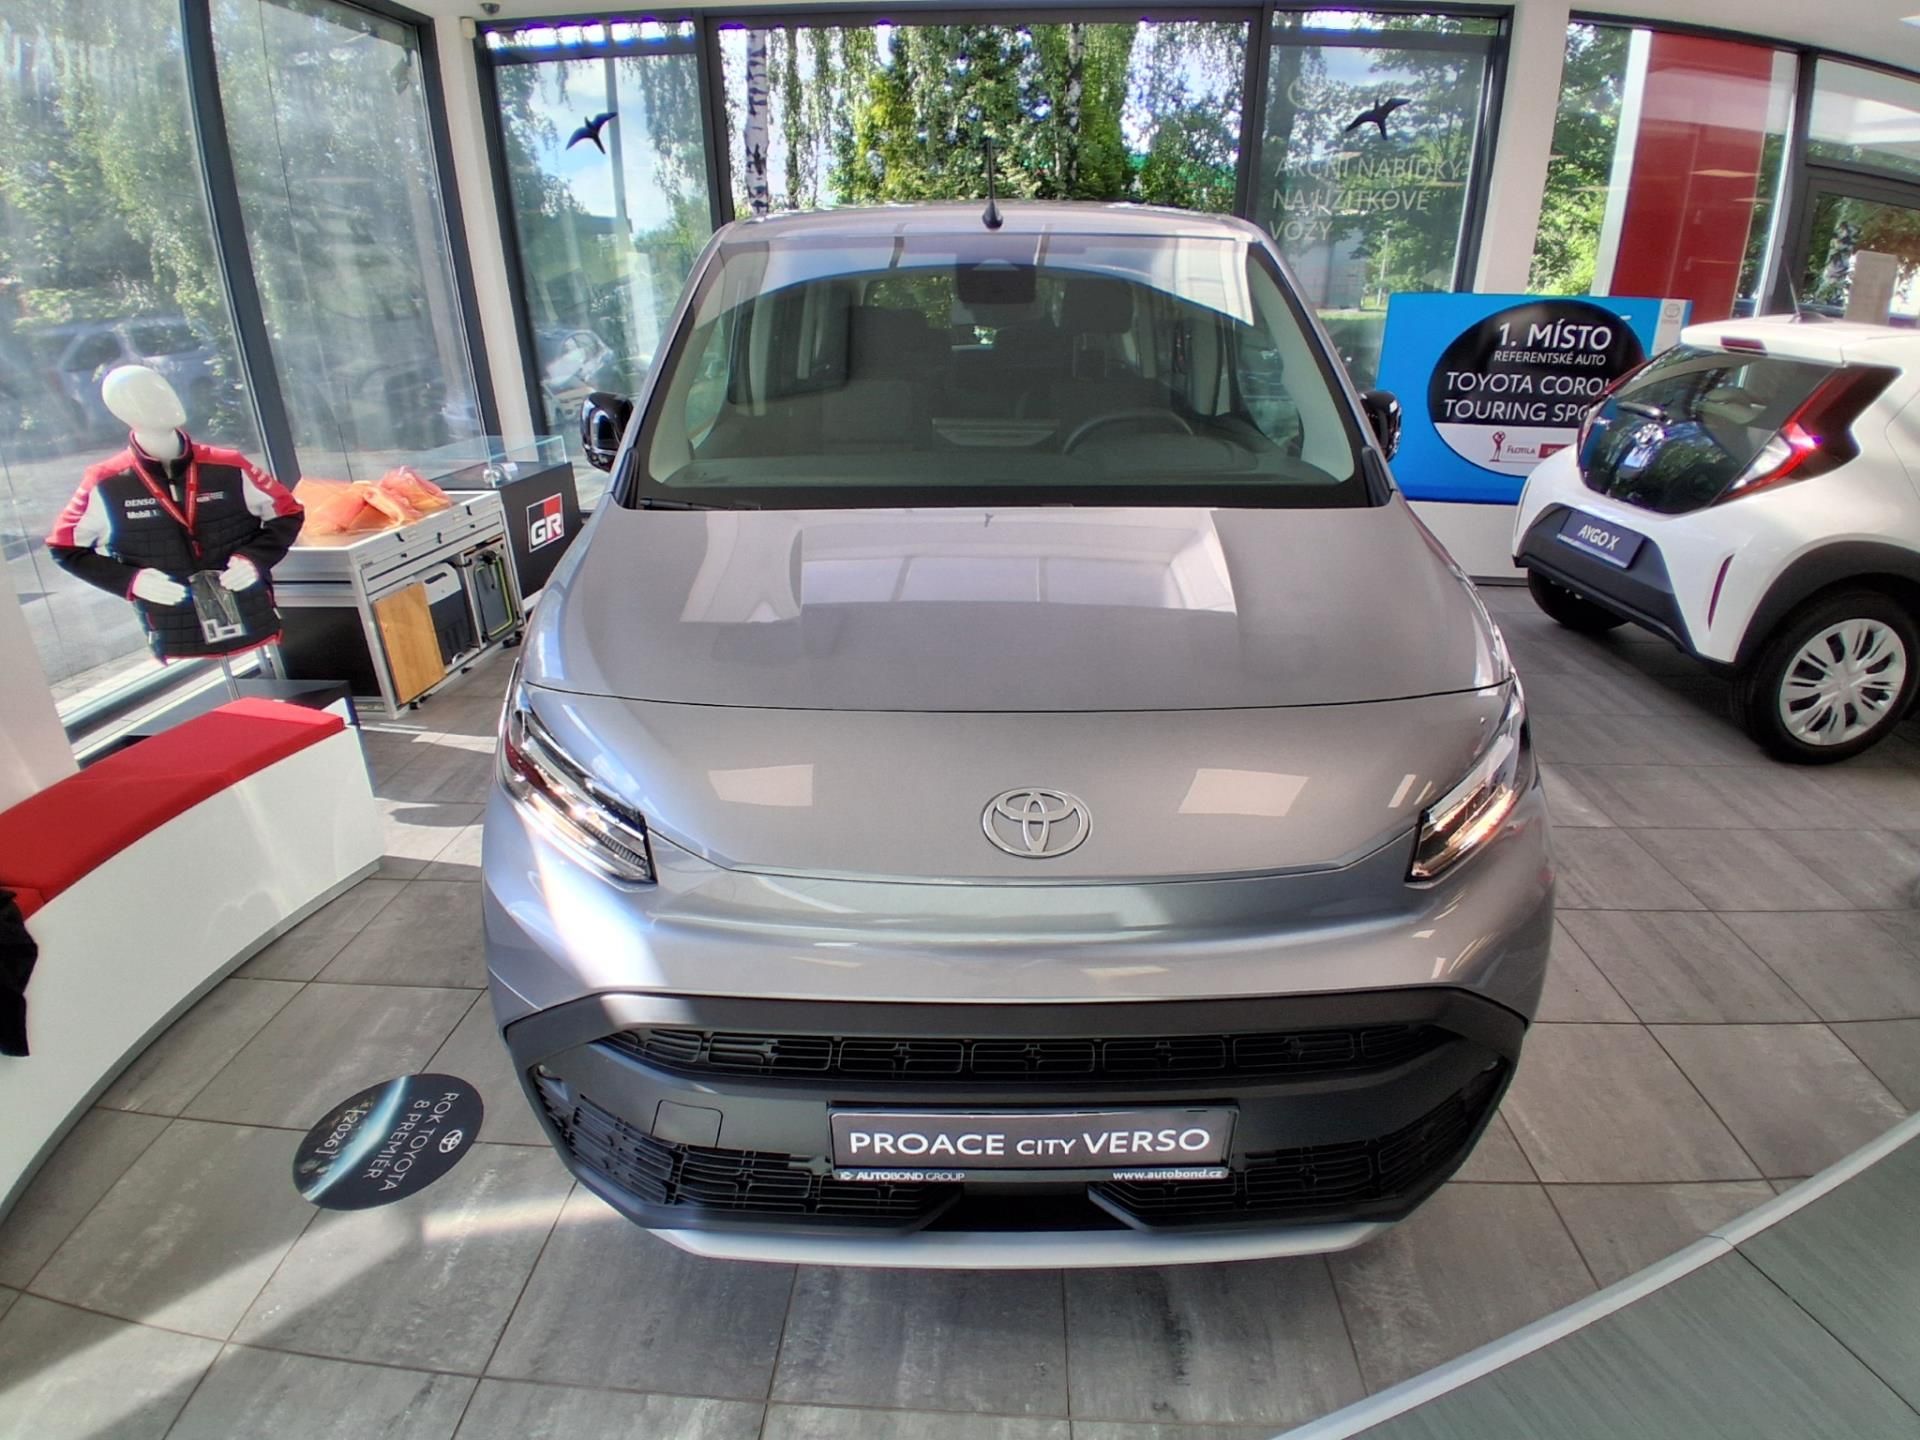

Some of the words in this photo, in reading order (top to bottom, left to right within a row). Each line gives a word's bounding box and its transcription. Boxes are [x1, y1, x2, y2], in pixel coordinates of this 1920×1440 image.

[1273, 189, 1306, 209] NA
[1269, 221, 1333, 241] VOZY
[1498, 322, 1517, 347] 1.
[1526, 319, 1612, 350] MÍSTO
[1494, 350, 1573, 365] REFERENTSKÉ
[1575, 354, 1606, 366] AUTO
[1446, 372, 1534, 393] TOYOTA
[1444, 399, 1547, 422] TOURING
[124, 498, 156, 507] DENSO
[126, 510, 151, 519] Mobil
[531, 512, 562, 546] GR
[1577, 524, 1609, 546] AYGO
[1607, 535, 1620, 551] X
[413, 1100, 430, 1109] 8
[424, 1092, 460, 1123] ROK
[363, 1113, 421, 1179] PREMIÉR
[849, 1132, 1005, 1155] PROACE
[1016, 1139, 1076, 1156] CITY
[1082, 1128, 1210, 1155] VERSO
[378, 1127, 436, 1191] TOYOTA
[855, 1171, 924, 1181] AUTOBOND
[925, 1172, 965, 1181] GROUP
[1112, 1168, 1224, 1180] www.autobond.cz
